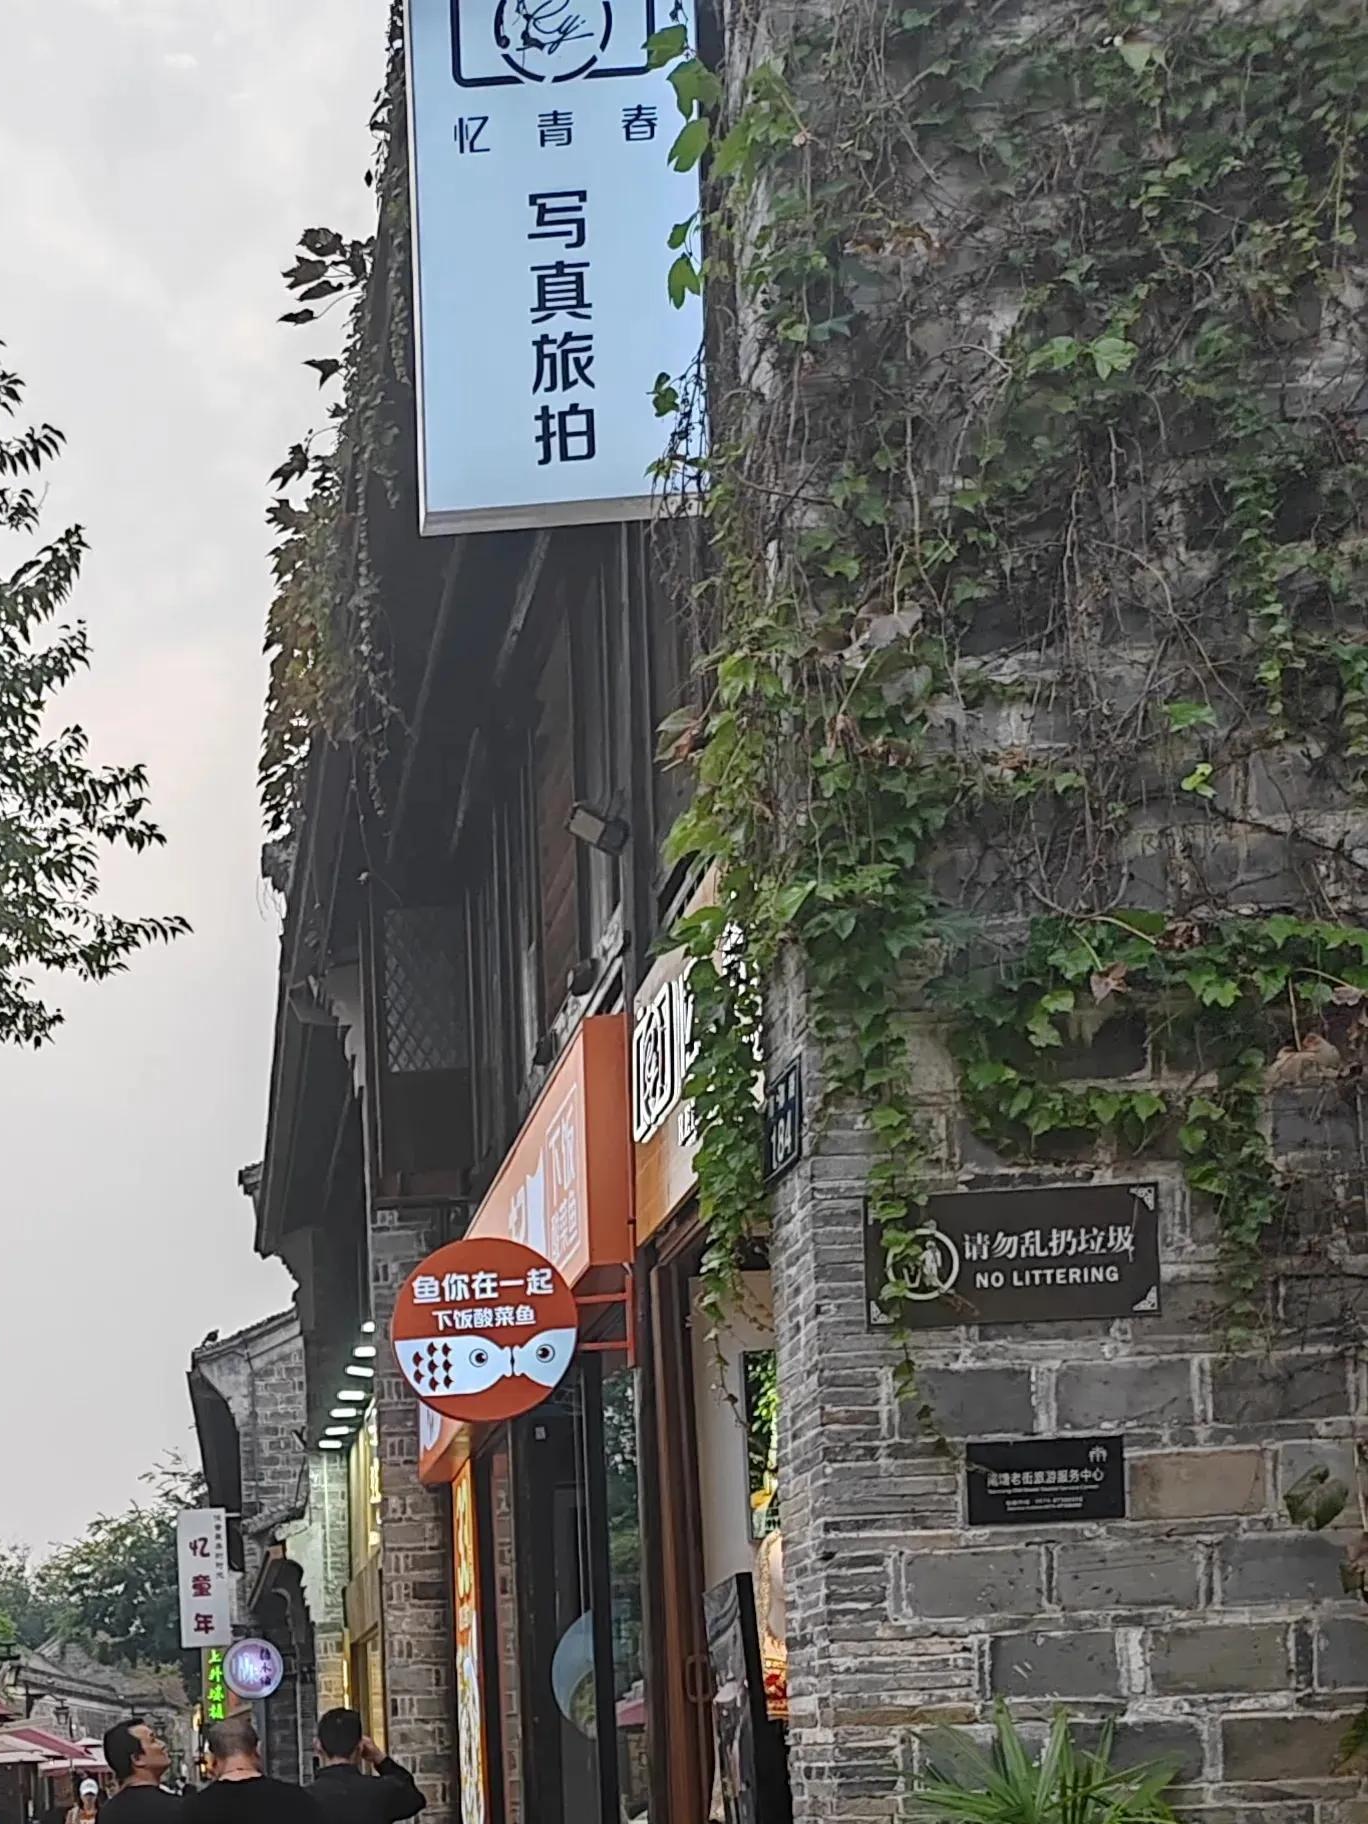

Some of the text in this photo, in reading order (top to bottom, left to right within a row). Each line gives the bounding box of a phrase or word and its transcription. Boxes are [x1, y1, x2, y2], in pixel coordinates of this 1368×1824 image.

[453, 104, 659, 154] 忆青春
[527, 189, 596, 466] 写真旅拍
[770, 1109, 792, 1170] 184
[963, 1224, 1133, 1261] 请勿乱扔垃圾
[411, 1267, 554, 1305] 鱼你在一起
[975, 1265, 1120, 1289] NO LITTERING
[432, 1304, 537, 1331] 下饭酸菜鱼
[188, 1537, 215, 1635] 忆童年
